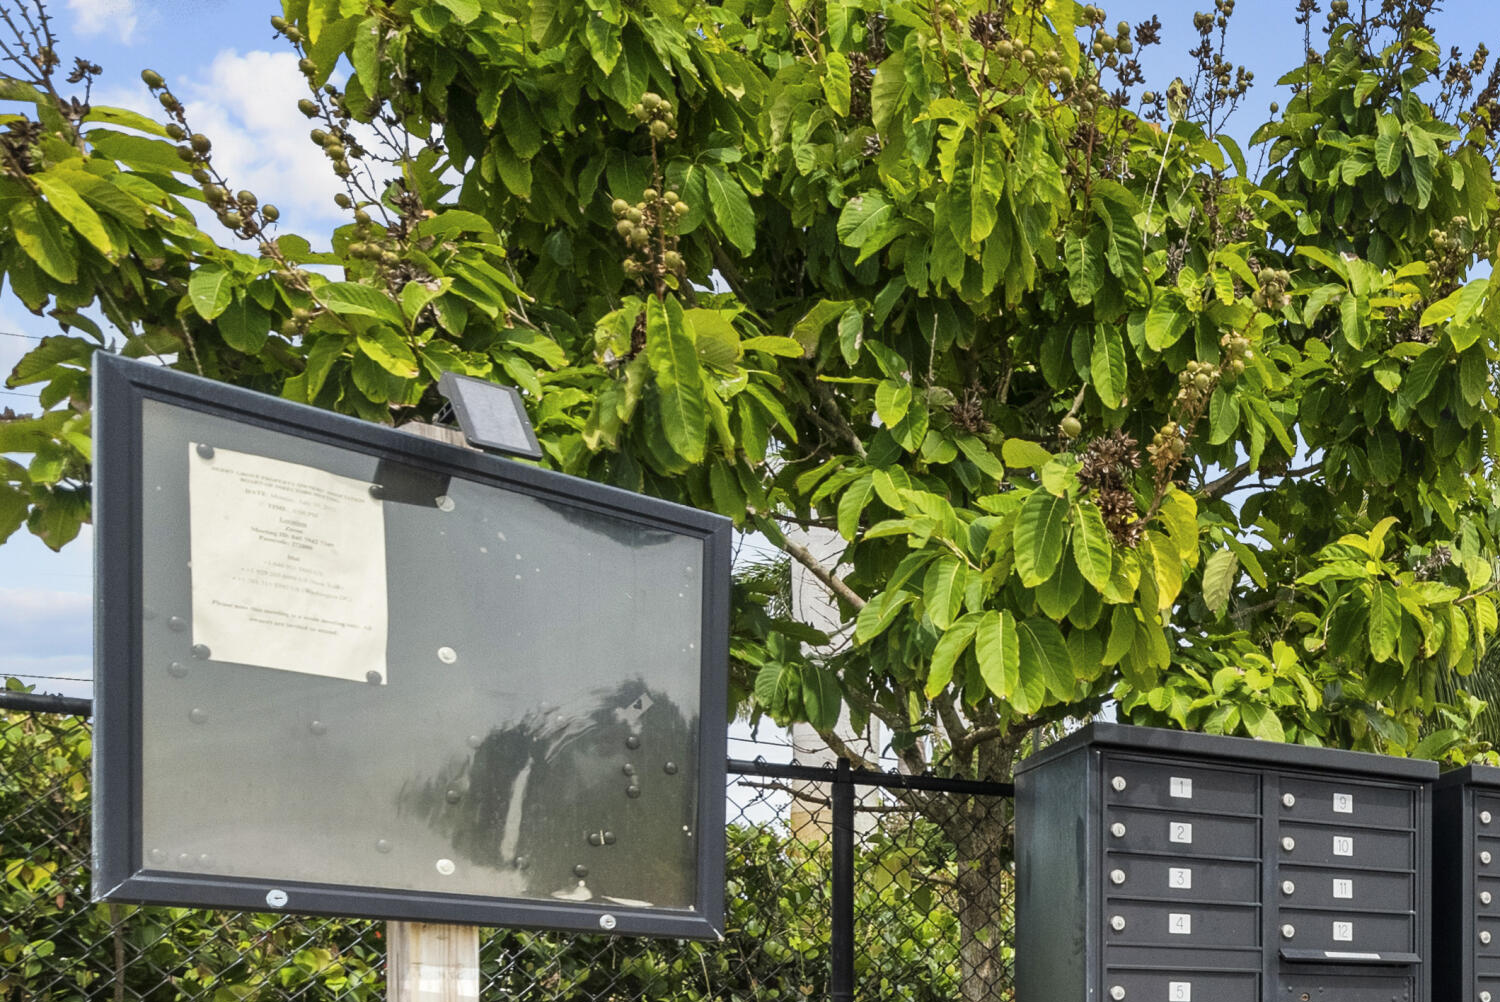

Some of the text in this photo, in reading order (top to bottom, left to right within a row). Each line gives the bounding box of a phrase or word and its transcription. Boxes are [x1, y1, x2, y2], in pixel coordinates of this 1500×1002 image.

[1339, 796, 1347, 810] 9
[1177, 825, 1185, 840] 2
[1338, 839, 1350, 853] 10
[1176, 871, 1185, 886] 3
[1339, 882, 1347, 896] 11
[1176, 916, 1184, 930] 4
[1338, 924, 1348, 938] 12
[1176, 985, 1184, 999] 5
